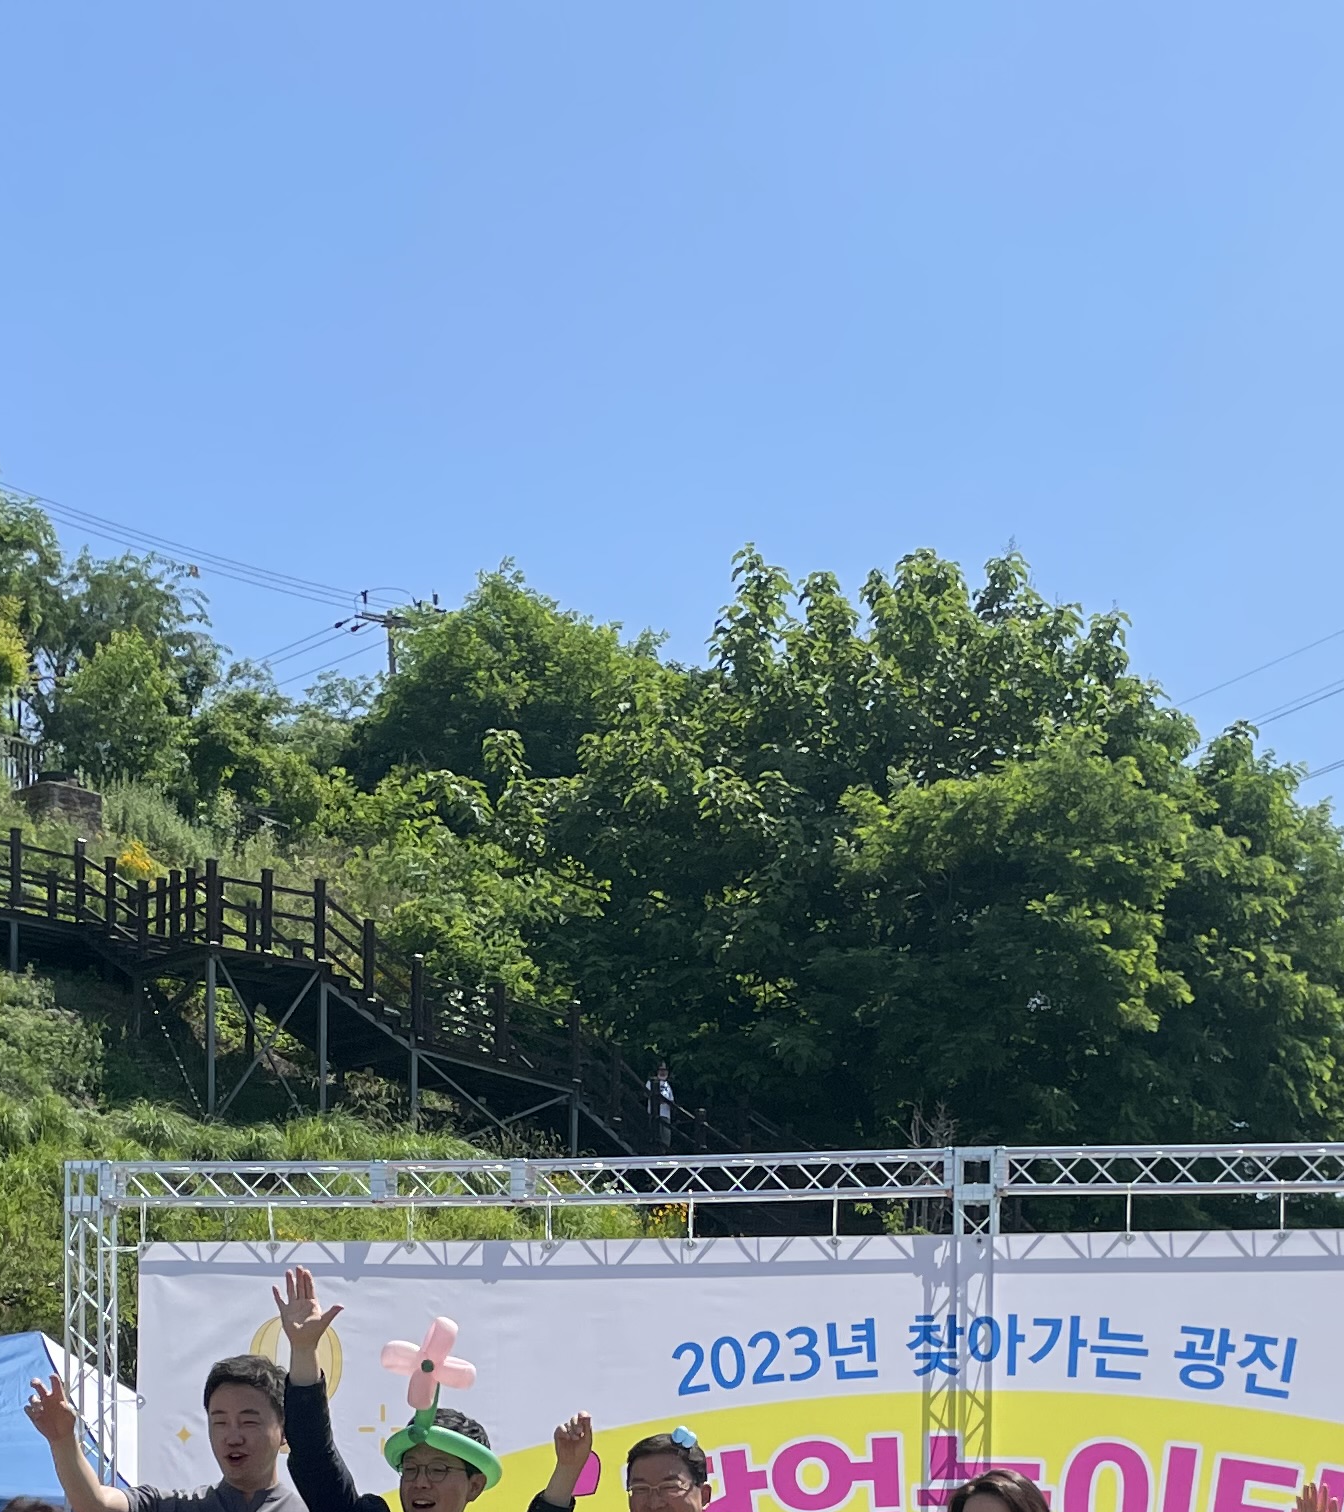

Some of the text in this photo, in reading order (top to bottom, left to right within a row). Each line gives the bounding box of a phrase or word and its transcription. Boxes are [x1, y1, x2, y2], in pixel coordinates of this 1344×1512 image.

[672, 1312, 1299, 1400] 2023년 찾아가는 광진
